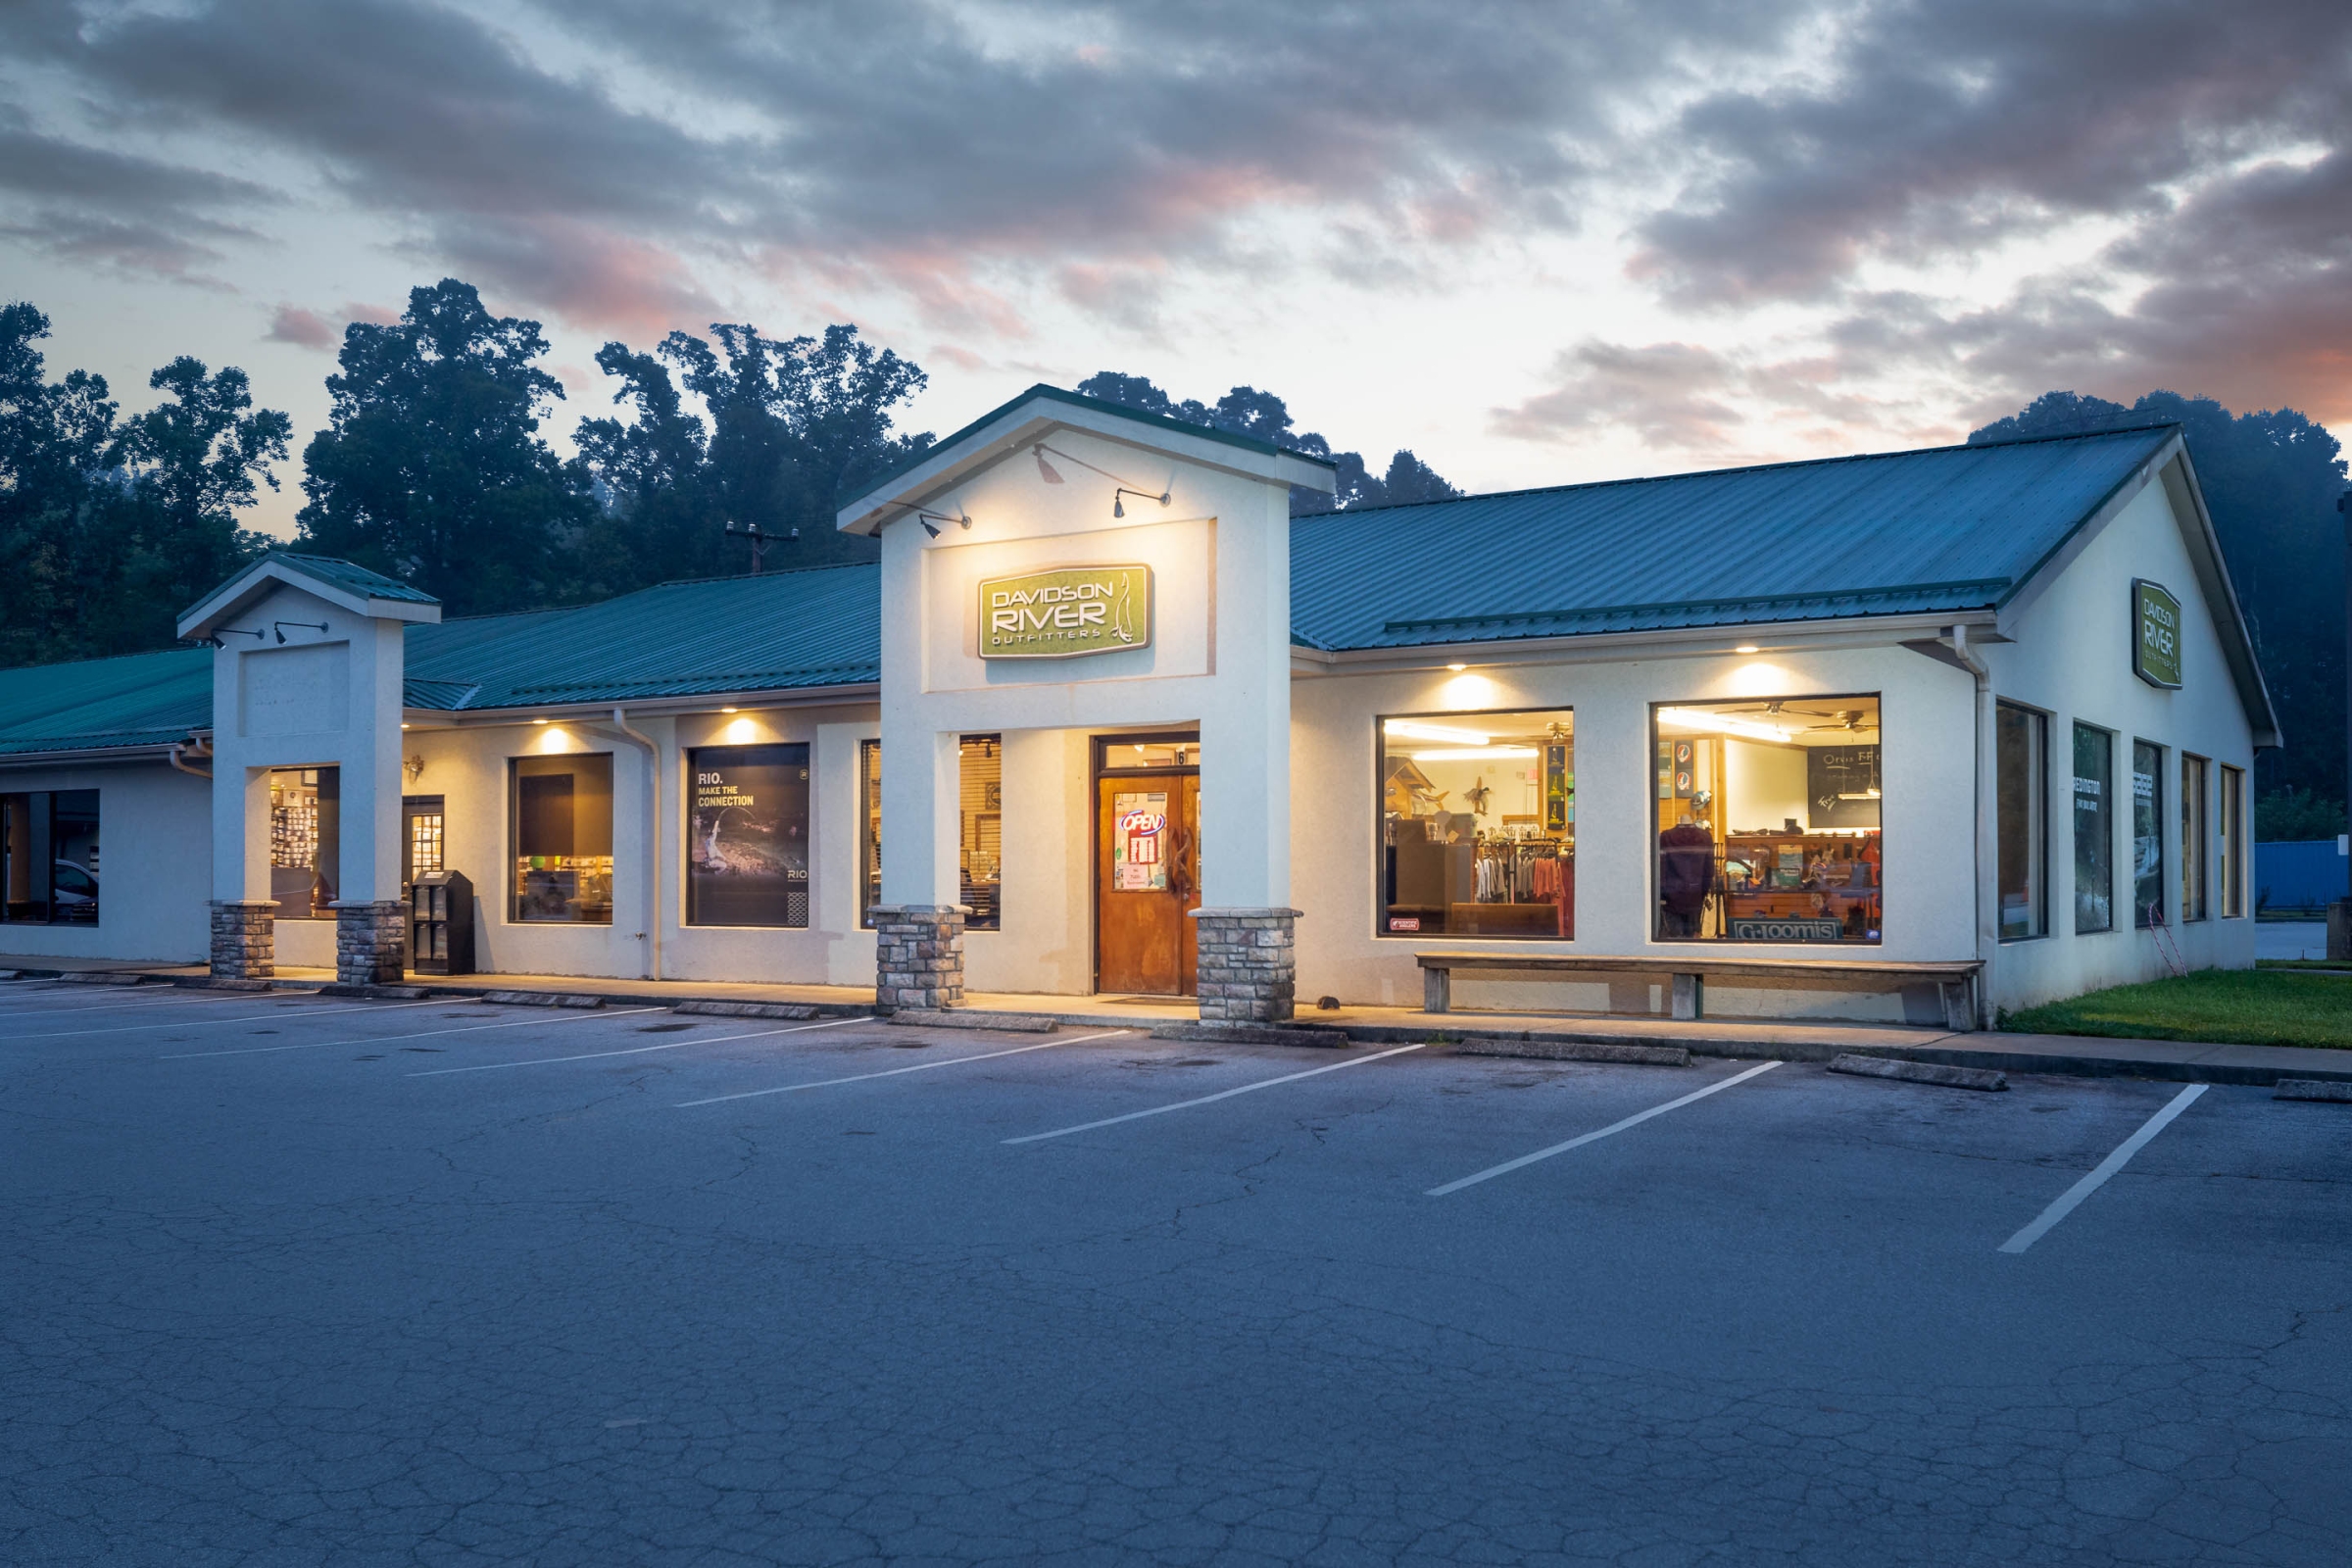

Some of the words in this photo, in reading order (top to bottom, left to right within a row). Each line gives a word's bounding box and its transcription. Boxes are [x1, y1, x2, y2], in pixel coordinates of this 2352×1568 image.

[992, 581, 1113, 609] DAVIDSON
[992, 602, 1106, 634] RIVER
[2144, 598, 2176, 629] DAVIDSON
[992, 628, 1101, 645] OUTFITTERS
[2144, 619, 2174, 658] RIVER
[698, 772, 723, 784] RIO.
[722, 786, 738, 795] THE
[698, 795, 754, 807] CONNECTION
[1122, 813, 1161, 831] OPEN
[788, 869, 808, 879] RIO
